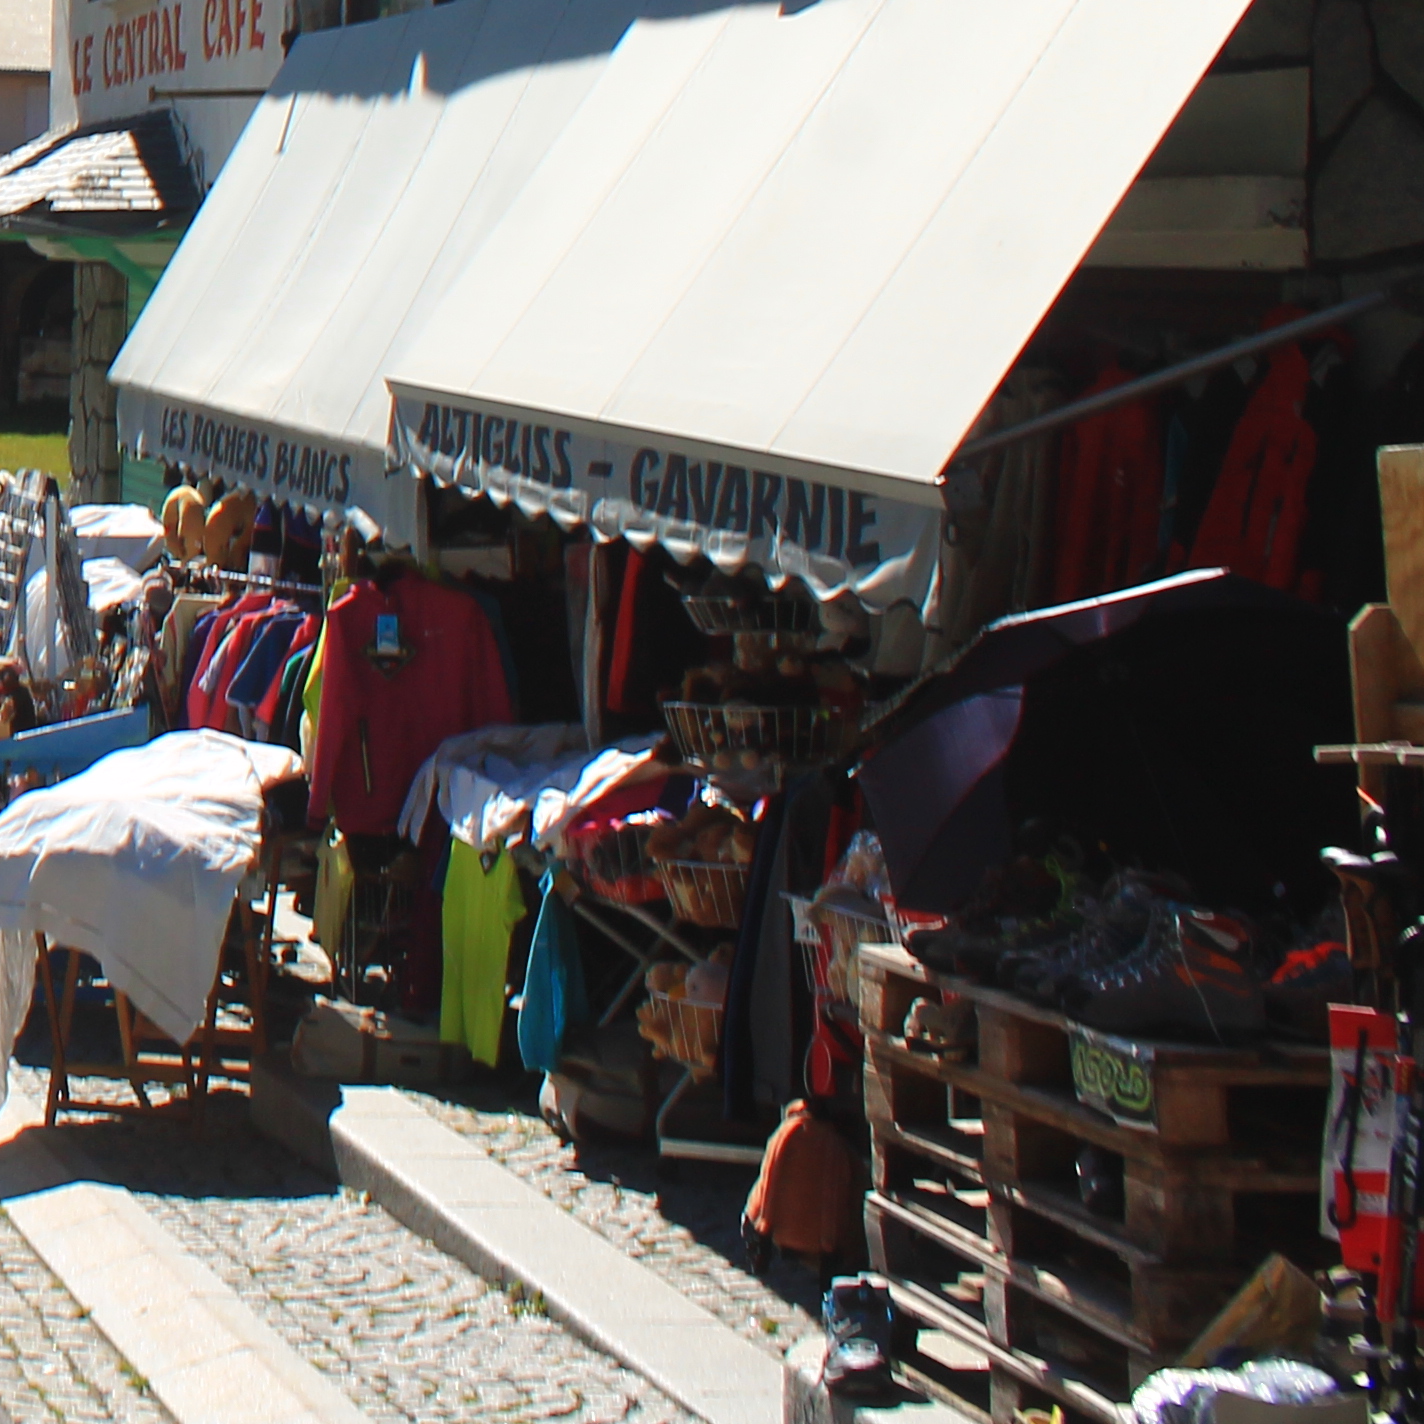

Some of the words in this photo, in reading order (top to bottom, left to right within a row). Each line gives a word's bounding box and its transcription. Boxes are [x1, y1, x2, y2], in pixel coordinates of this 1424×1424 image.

[73, 33, 94, 96] LE
[104, 2, 186, 90] CENTRAL
[160, 406, 188, 451] LES
[190, 413, 270, 480] ROCHERS
[272, 439, 351, 504] BLANCS
[417, 403, 572, 488] ALTIGLISS
[630, 448, 880, 564] GAVARNIE
